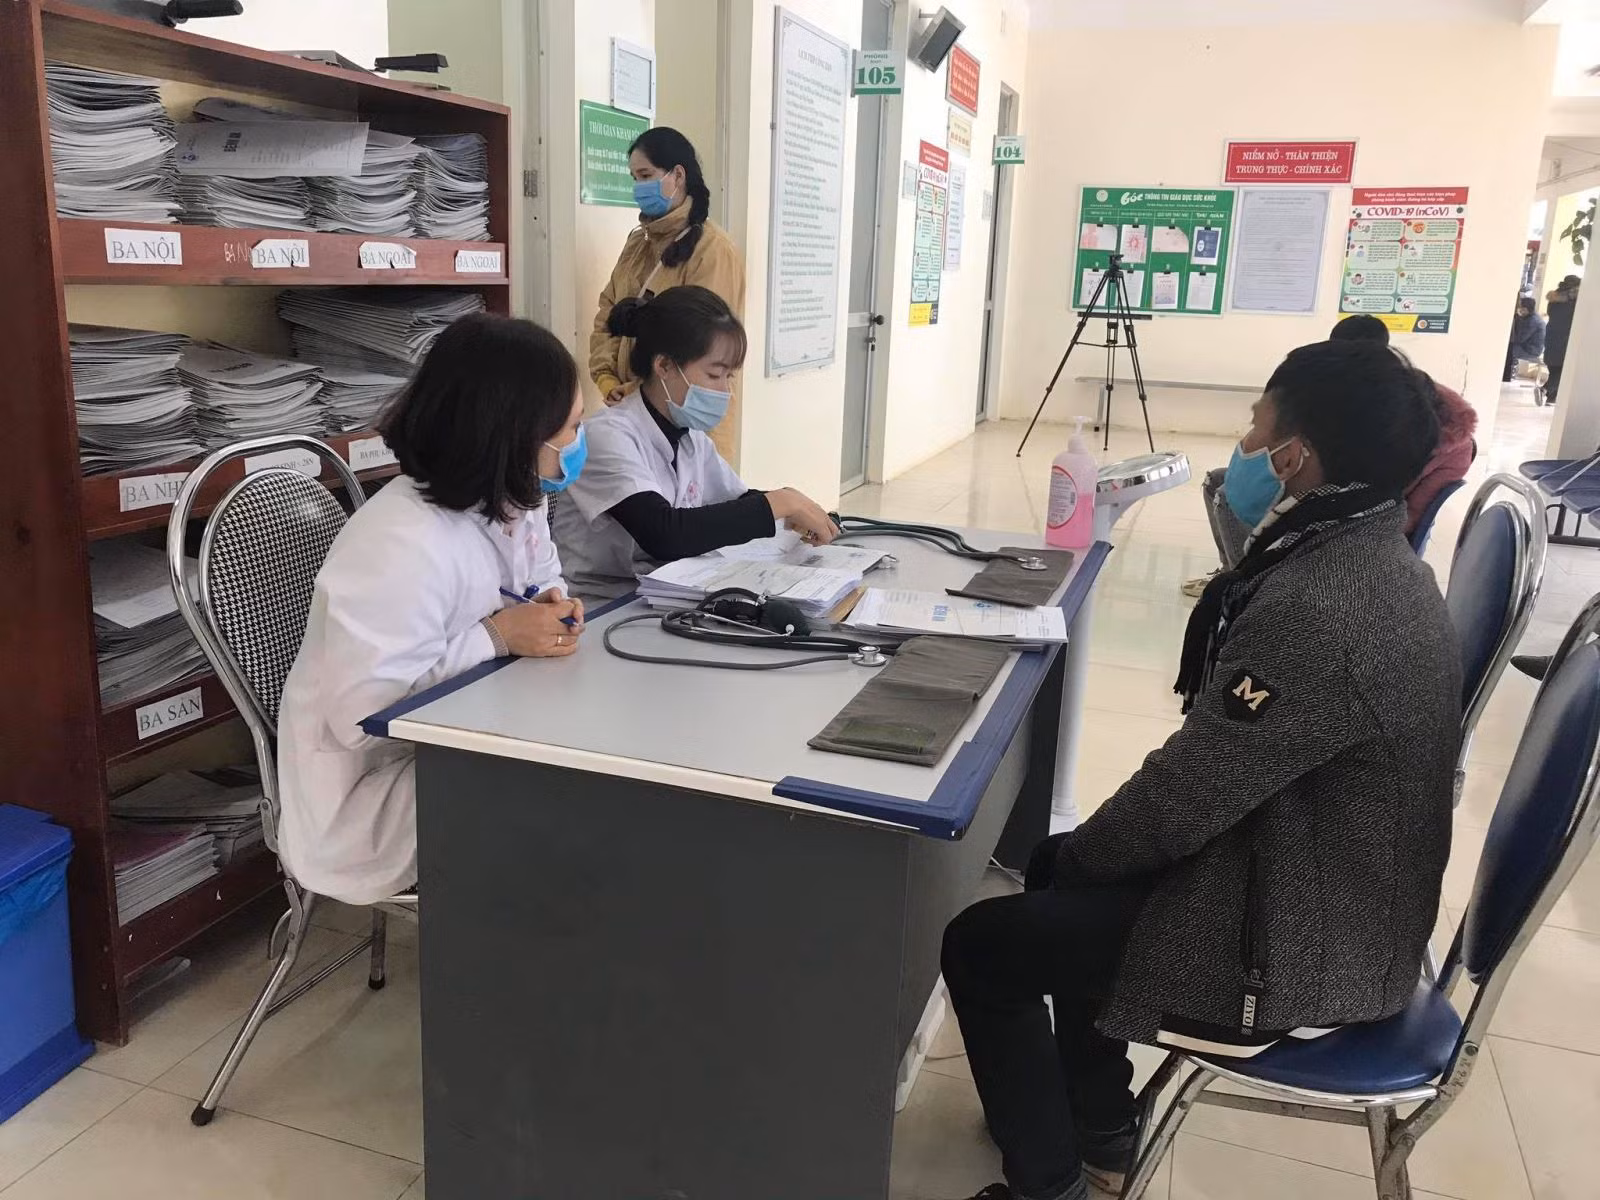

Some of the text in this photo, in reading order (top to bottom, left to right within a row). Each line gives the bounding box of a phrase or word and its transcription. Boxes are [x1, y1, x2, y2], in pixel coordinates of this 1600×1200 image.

[856, 66, 896, 85] 105
[996, 145, 1022, 158] 104
[1236, 165, 1264, 174] TRUNG
[1294, 164, 1322, 174] CHÍNH
[1323, 163, 1342, 174] XÁC
[112, 237, 176, 262] BA NỘI
[256, 247, 276, 264] BA
[361, 251, 376, 264] BA
[458, 256, 468, 268] BA
[126, 484, 150, 502] BA
[1232, 676, 1270, 711] M
[140, 711, 163, 732] BA
[1244, 996, 1254, 1024] ZIYO
